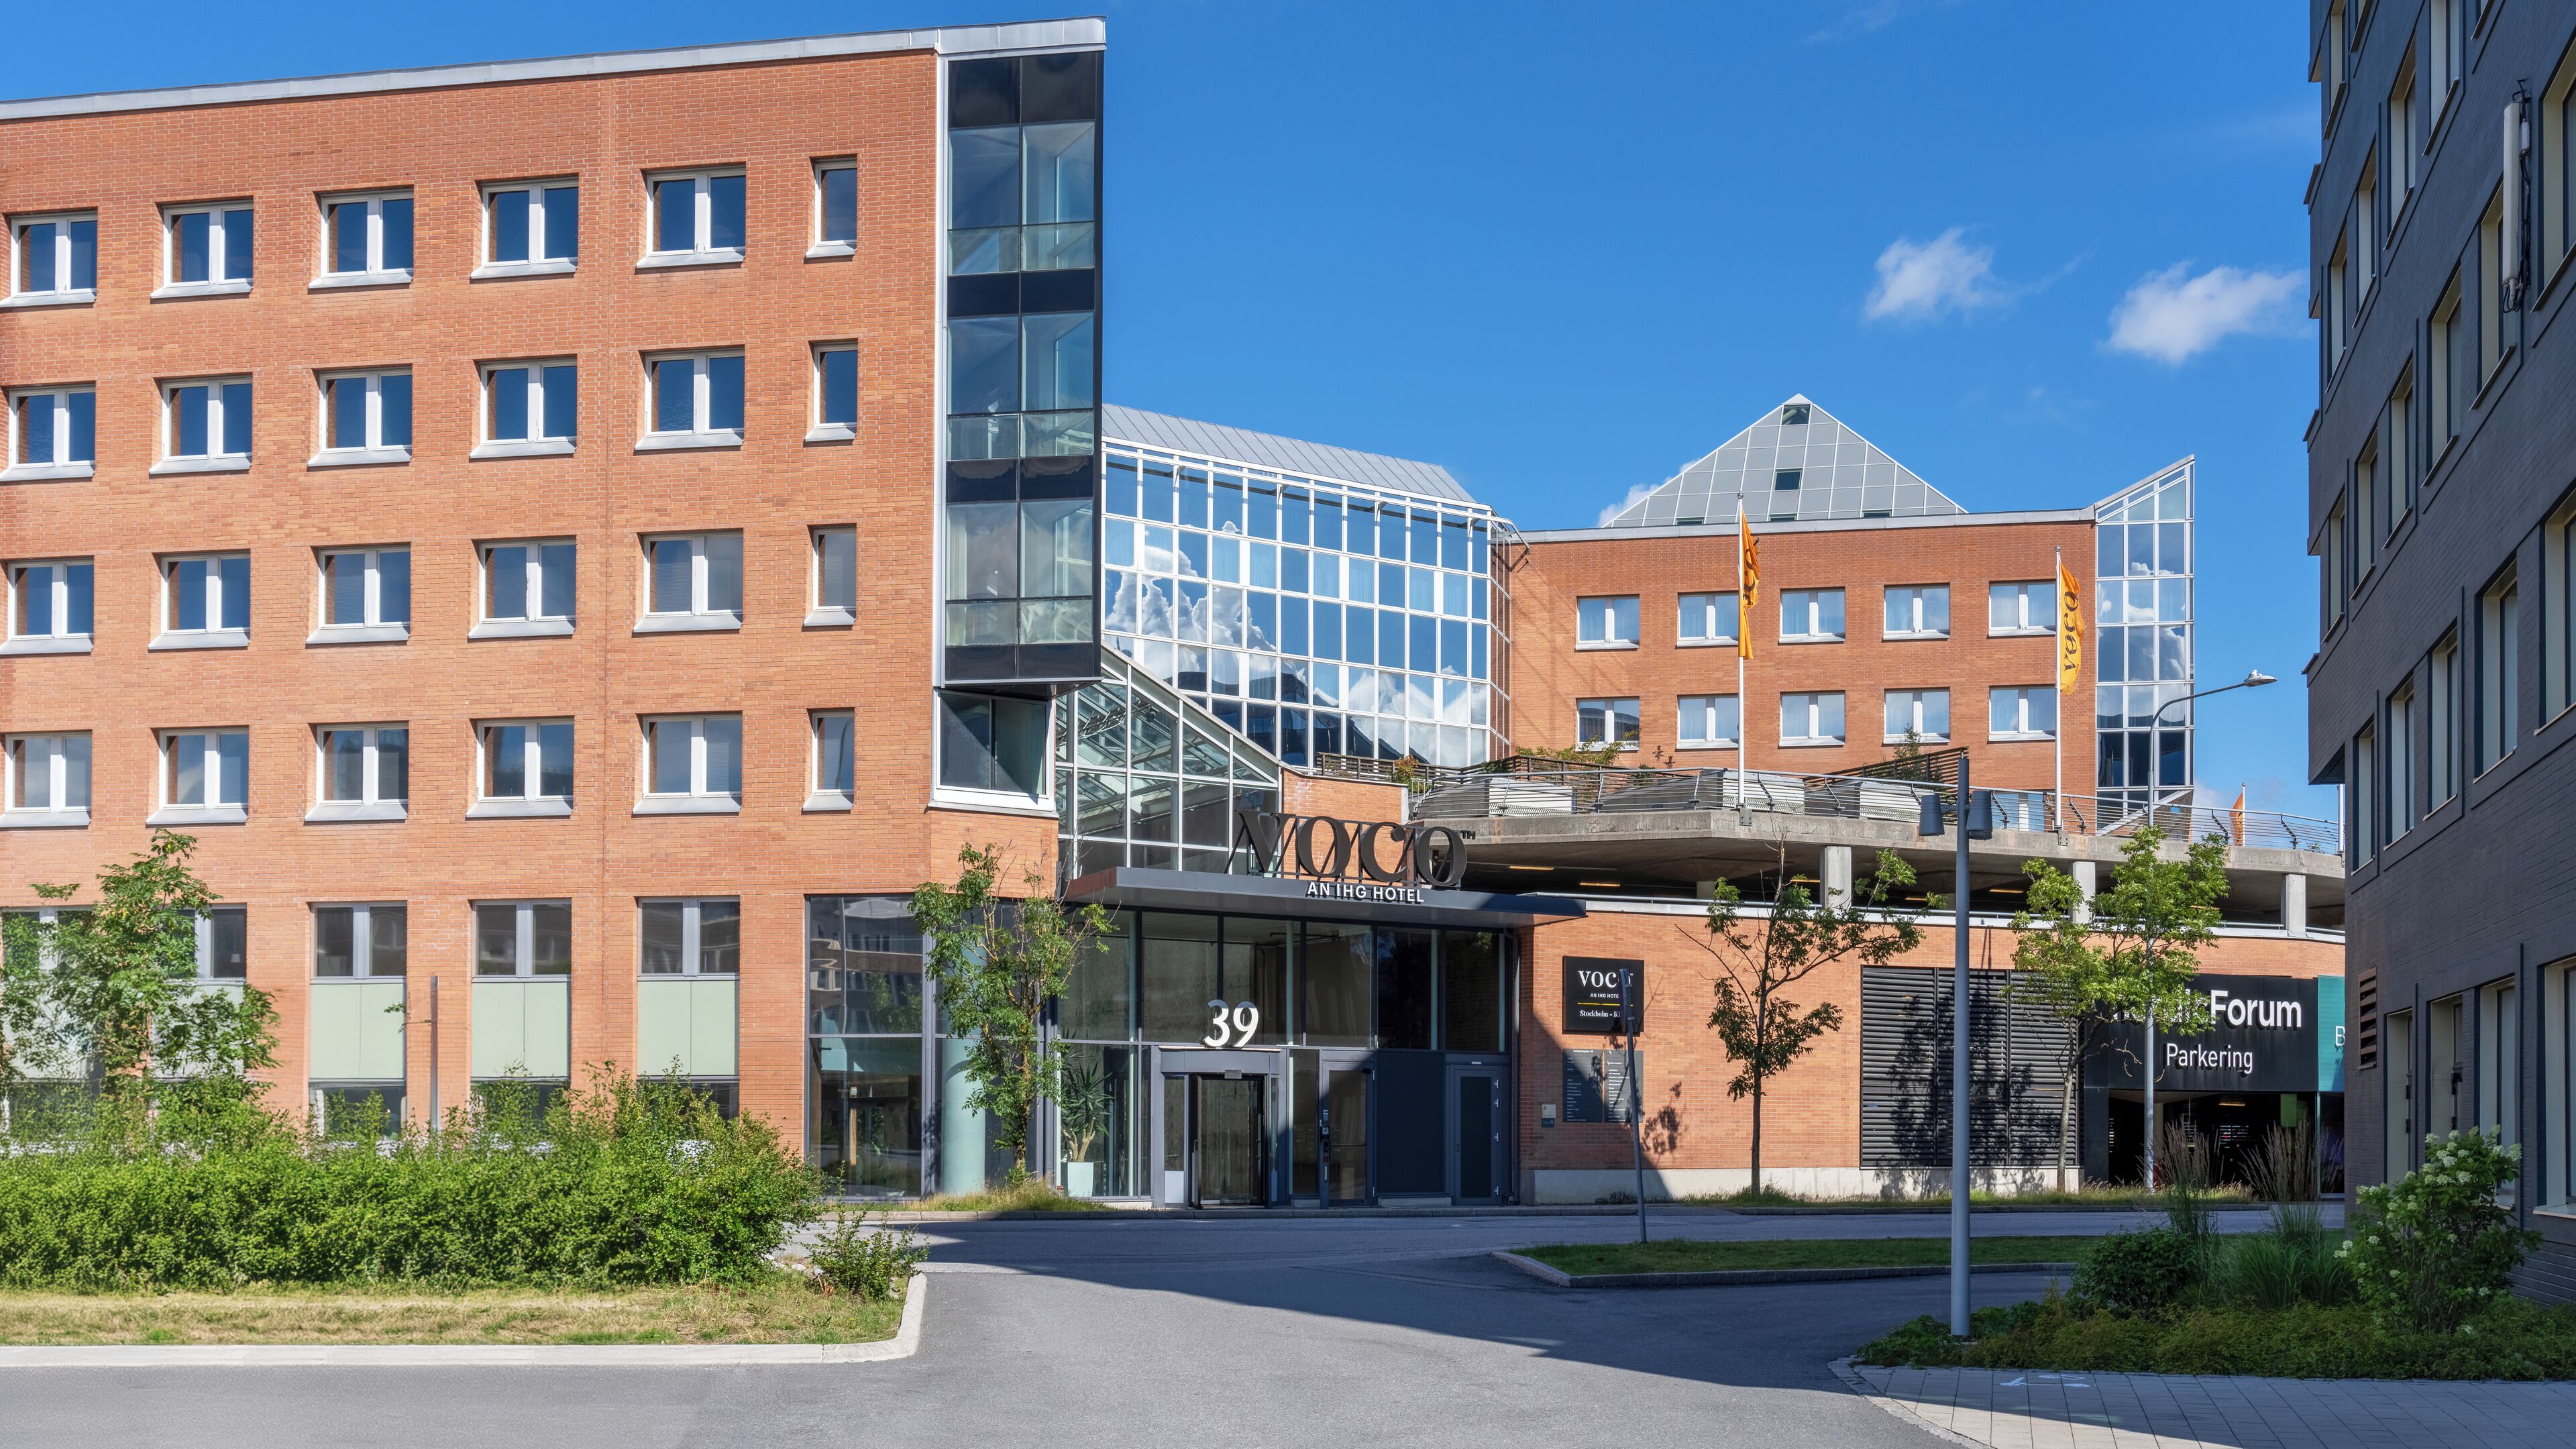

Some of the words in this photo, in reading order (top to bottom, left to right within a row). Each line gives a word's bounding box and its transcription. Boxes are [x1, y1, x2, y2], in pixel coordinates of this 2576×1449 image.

[1307, 881, 1330, 896] AN
[1336, 883, 1366, 899] IHG
[1373, 886, 1424, 903] HOTEL
[1578, 970, 1631, 988] voc
[1203, 999, 1258, 1048] 39
[1580, 1010, 1609, 1018] Stockholm
[2166, 1042, 2253, 1074] Parkering
